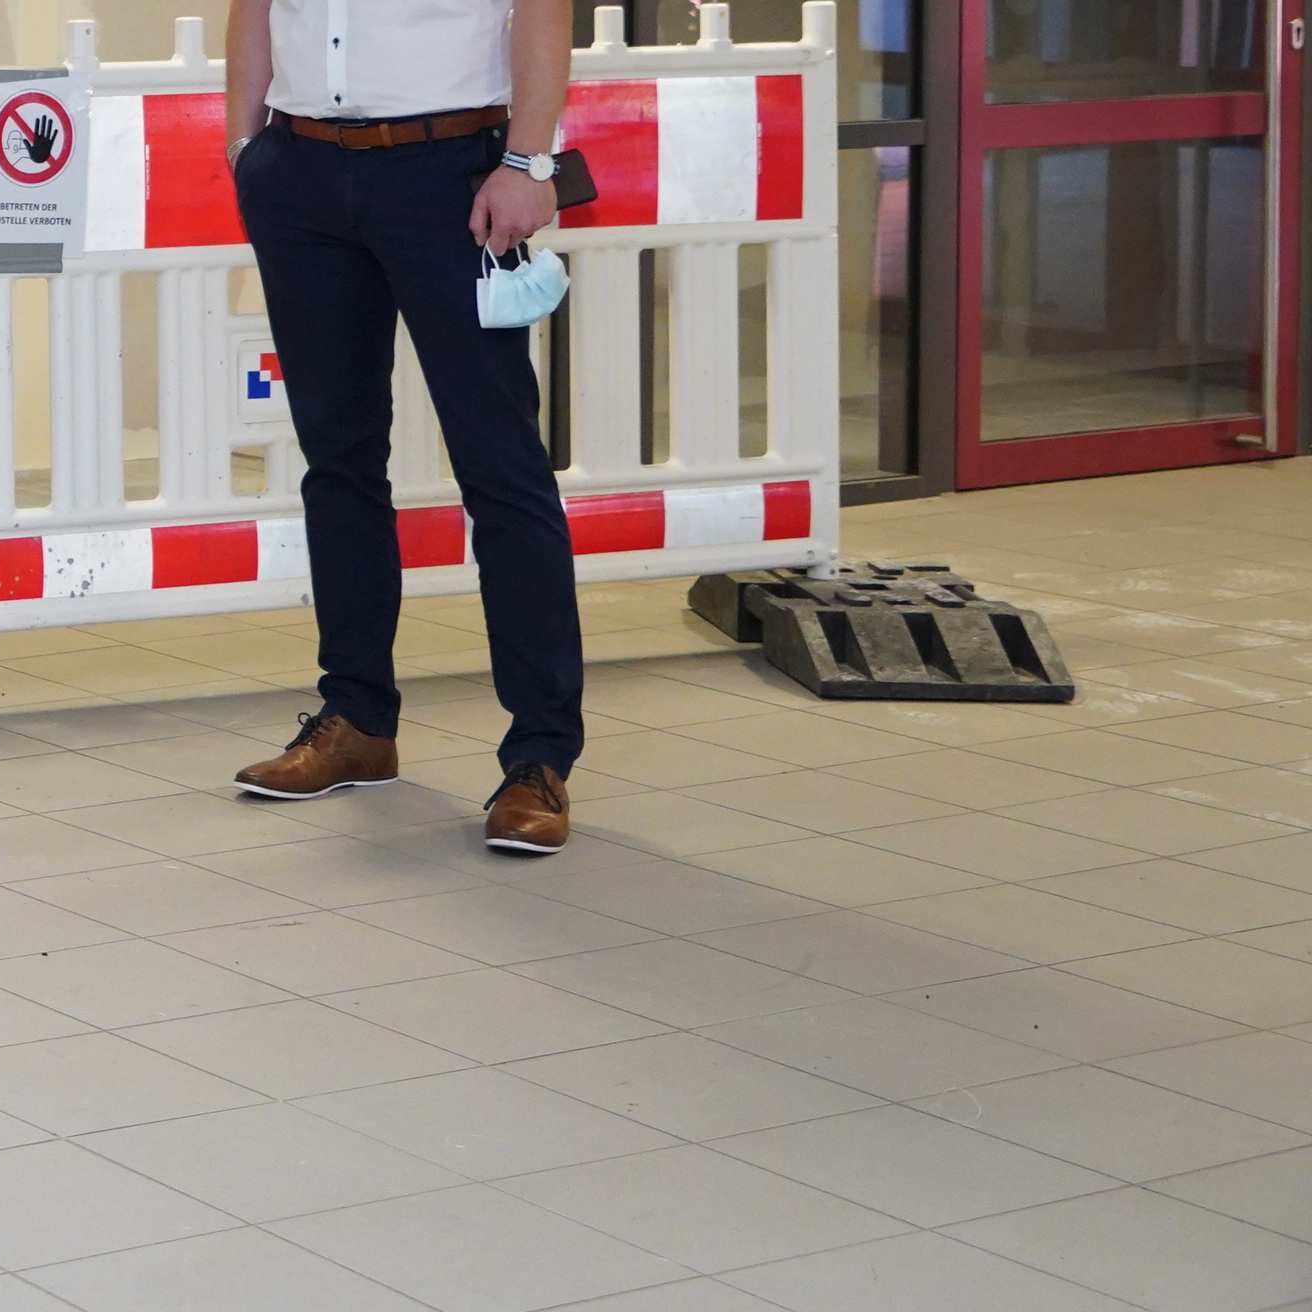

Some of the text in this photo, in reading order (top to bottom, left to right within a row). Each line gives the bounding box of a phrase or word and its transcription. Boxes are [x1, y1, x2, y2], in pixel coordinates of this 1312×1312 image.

[0, 202, 57, 212] BETRETEN DER
[29, 216, 72, 226] VERBOTEN
